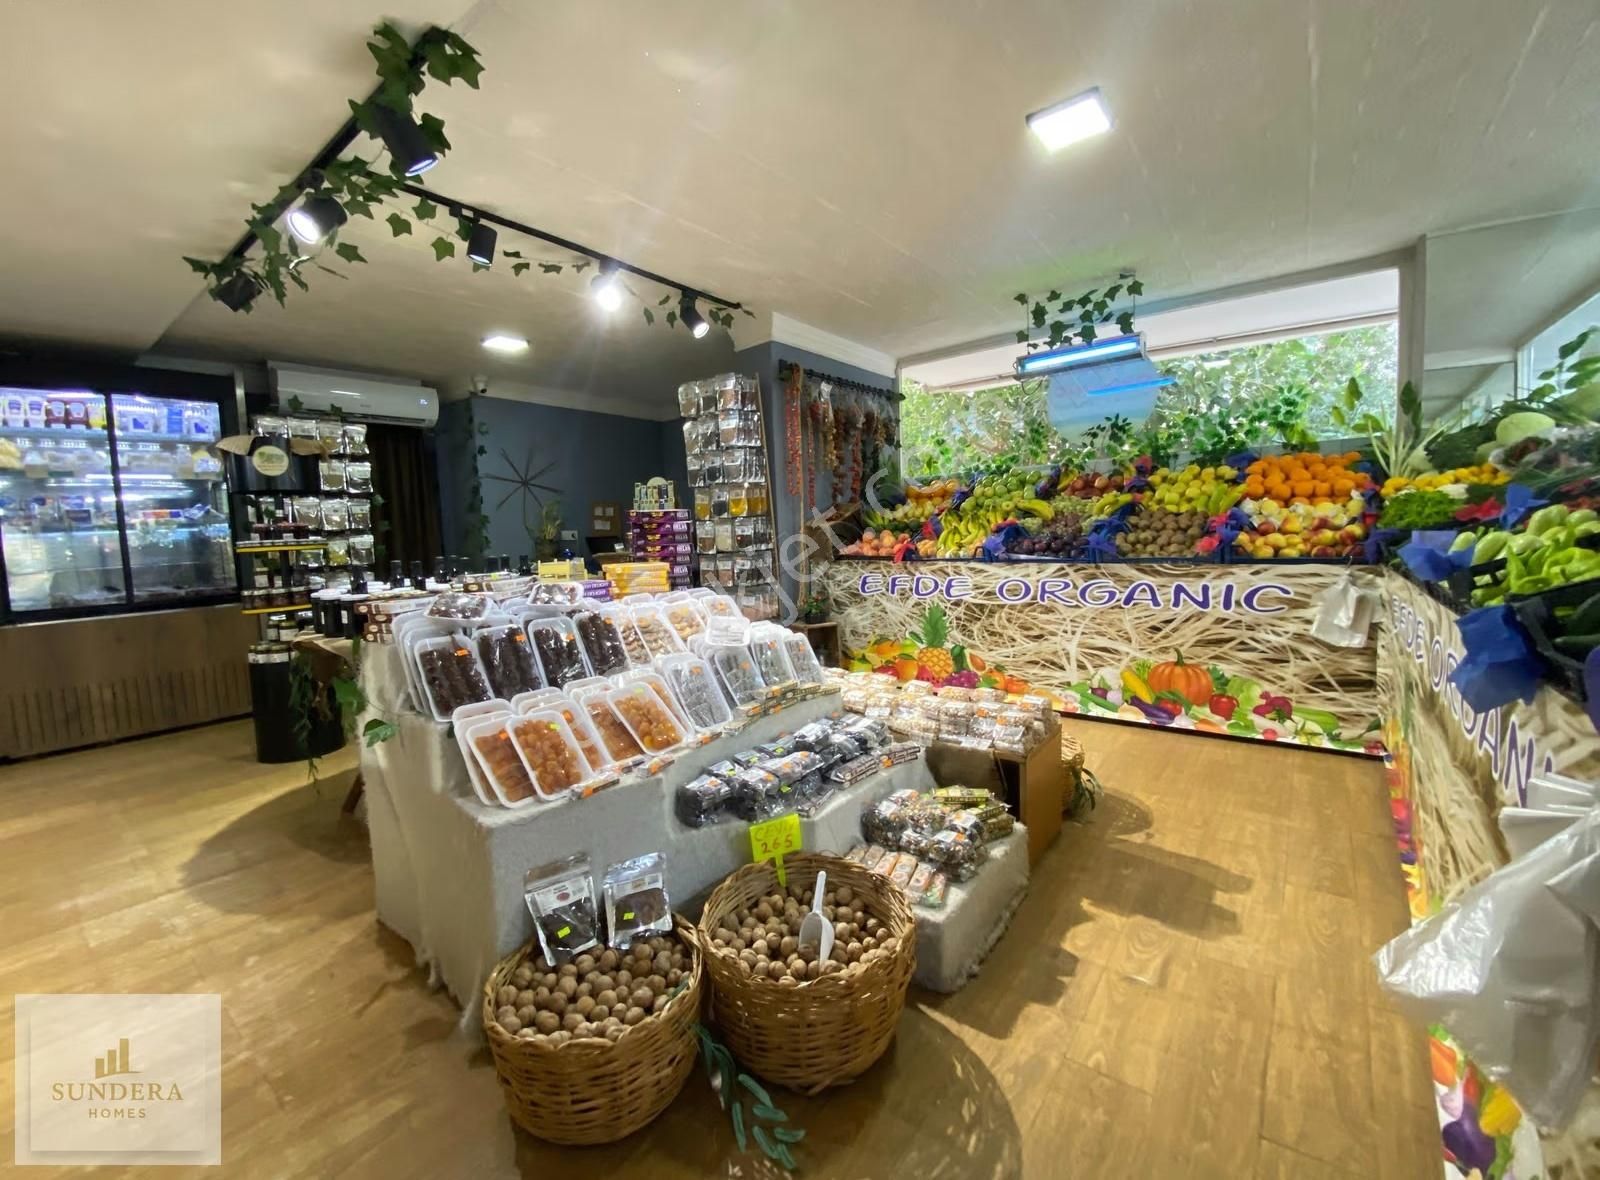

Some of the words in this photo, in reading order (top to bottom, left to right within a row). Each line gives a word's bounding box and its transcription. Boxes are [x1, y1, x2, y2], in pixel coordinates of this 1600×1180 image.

[859, 573, 974, 600] EFDE
[996, 578, 1294, 615] ORGANIC
[761, 833, 793, 854] 265
